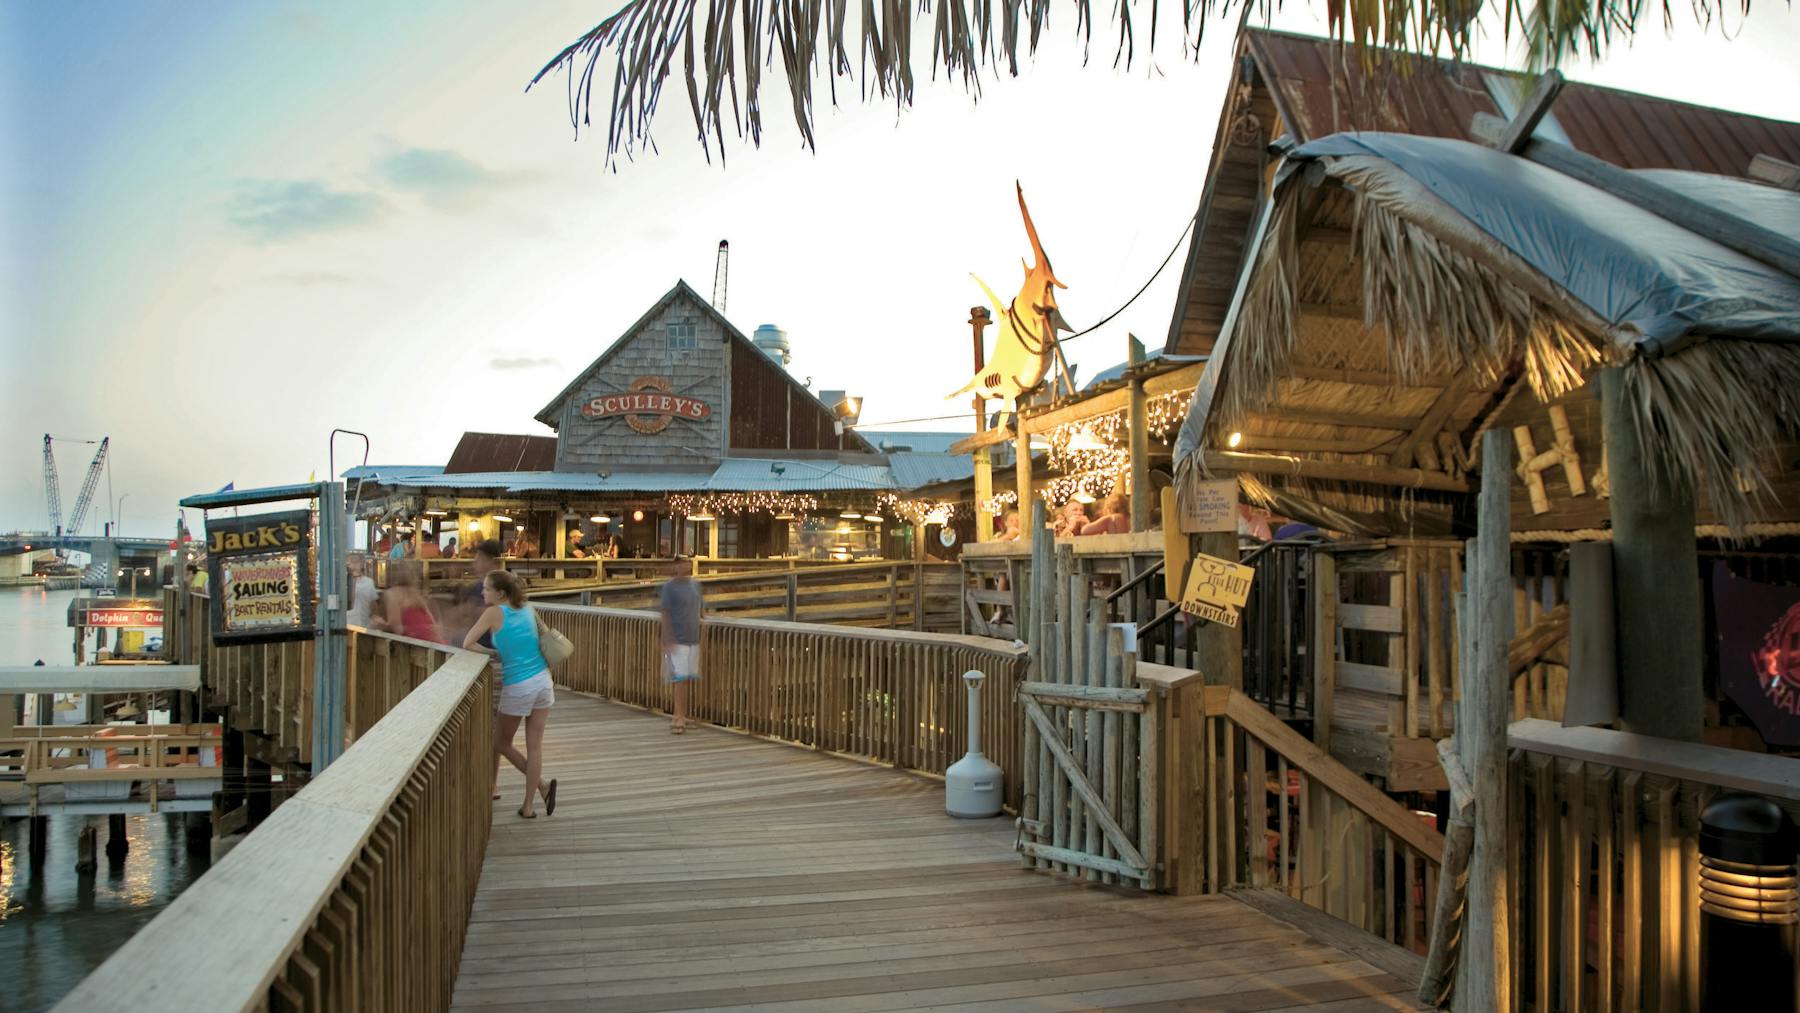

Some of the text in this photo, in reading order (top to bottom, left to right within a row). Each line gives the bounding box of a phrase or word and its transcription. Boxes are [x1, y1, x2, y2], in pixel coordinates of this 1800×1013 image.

[590, 395, 703, 417] SCULLEY'S
[1199, 501, 1231, 510] SMOKING
[233, 580, 289, 600] SAILING
[1225, 574, 1250, 597] HUT
[91, 612, 128, 624] Dolphin
[234, 600, 292, 617] BOAT RENTALS
[1184, 600, 1236, 626] DOWNSTAIRS
